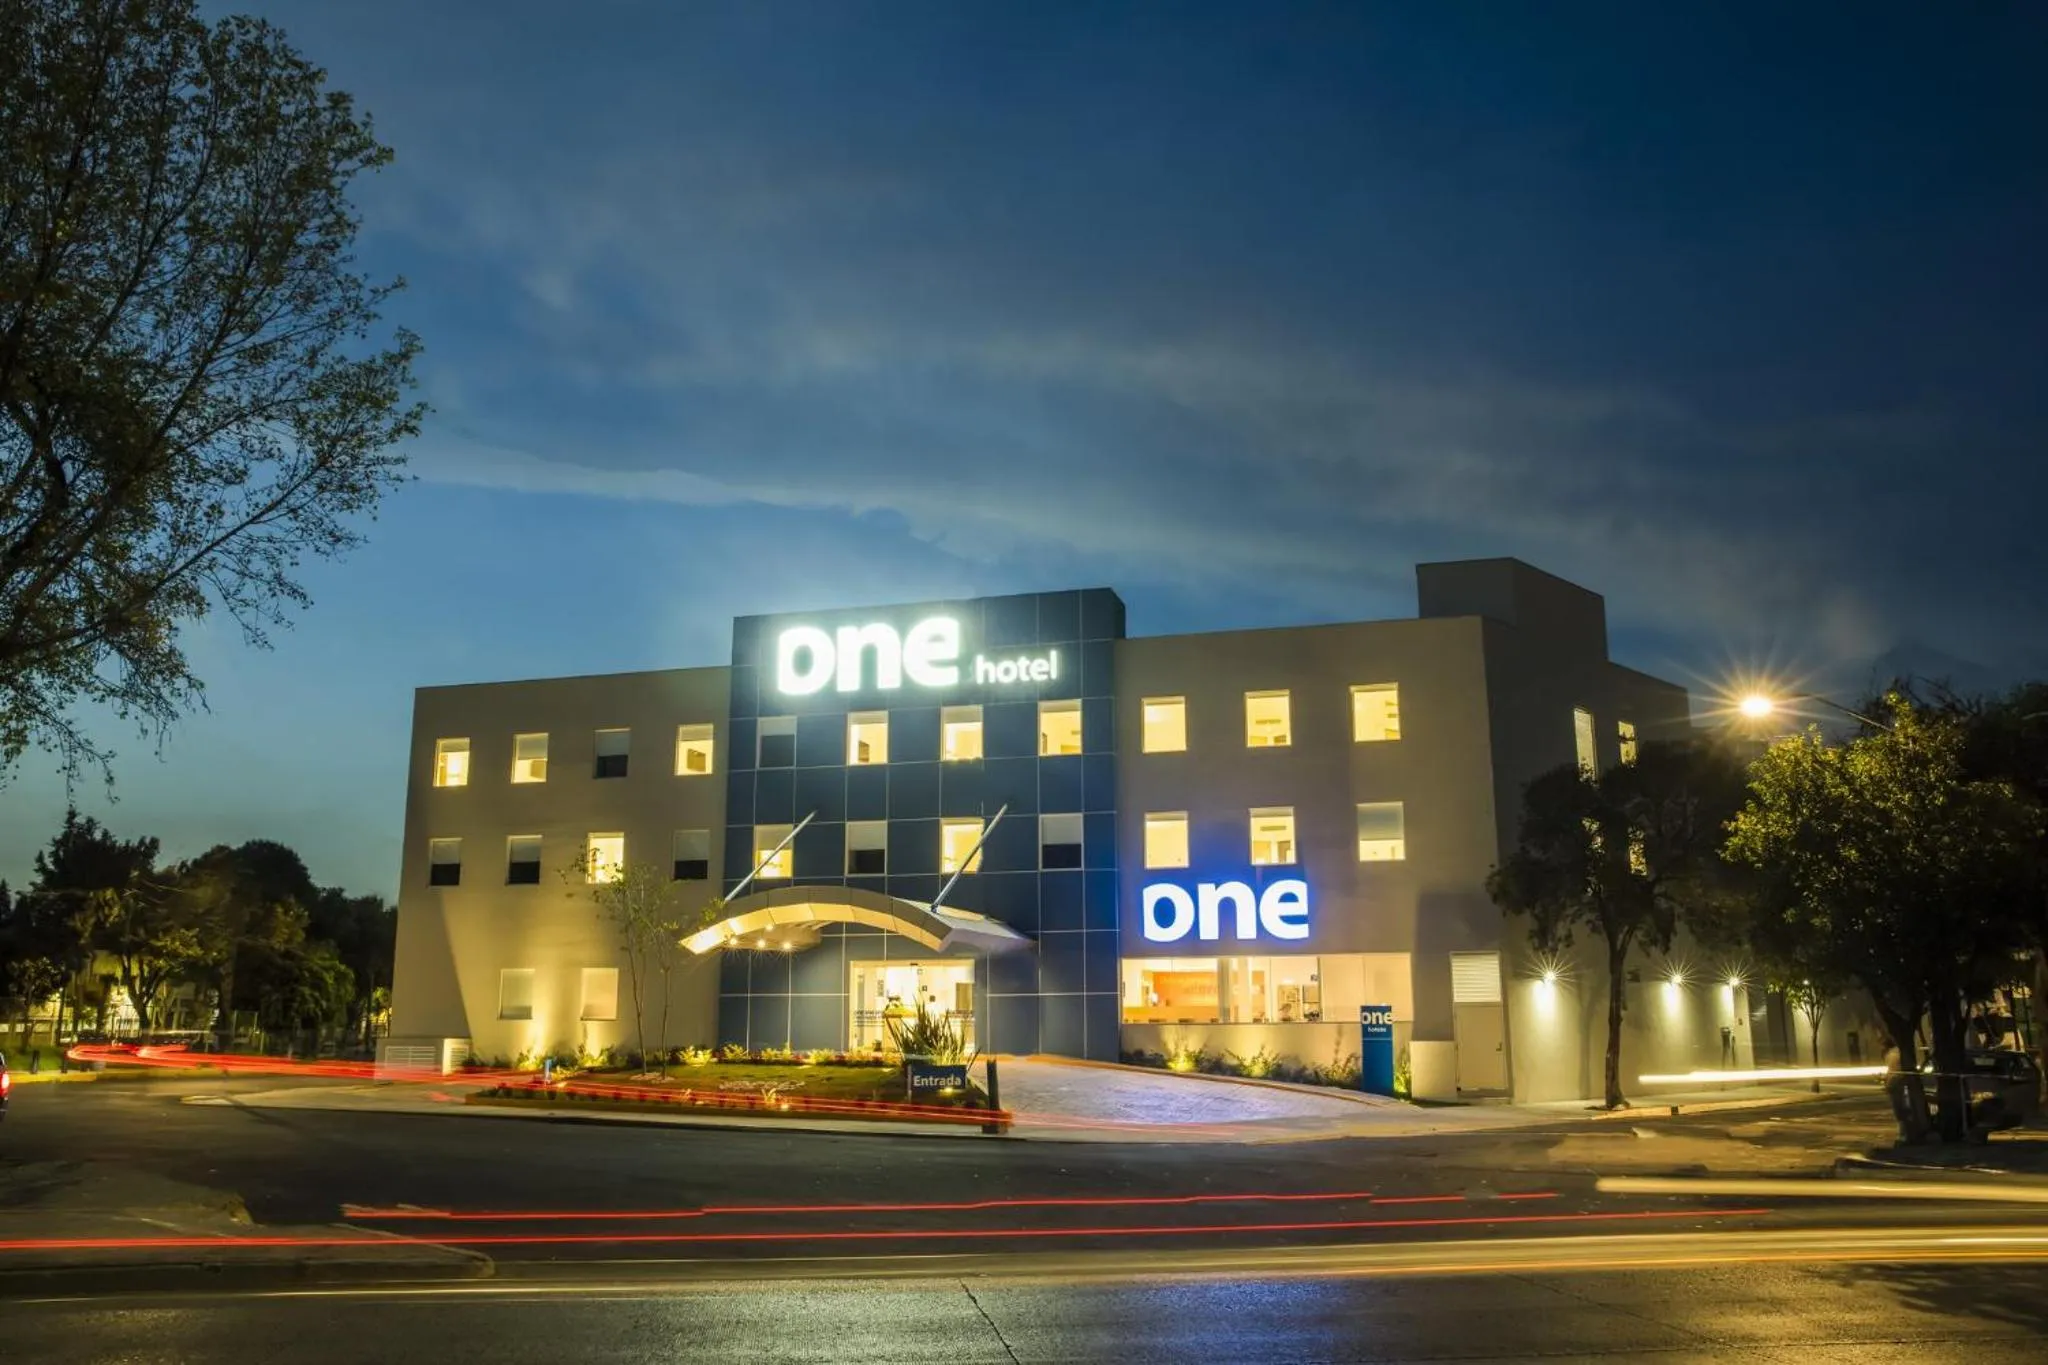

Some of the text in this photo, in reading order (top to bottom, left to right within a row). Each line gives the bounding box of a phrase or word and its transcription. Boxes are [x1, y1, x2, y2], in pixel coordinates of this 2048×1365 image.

[777, 616, 1058, 695] one hotel
[1142, 879, 1309, 942] one
[1361, 1011, 1393, 1025] one
[913, 1073, 962, 1087] Entrada
